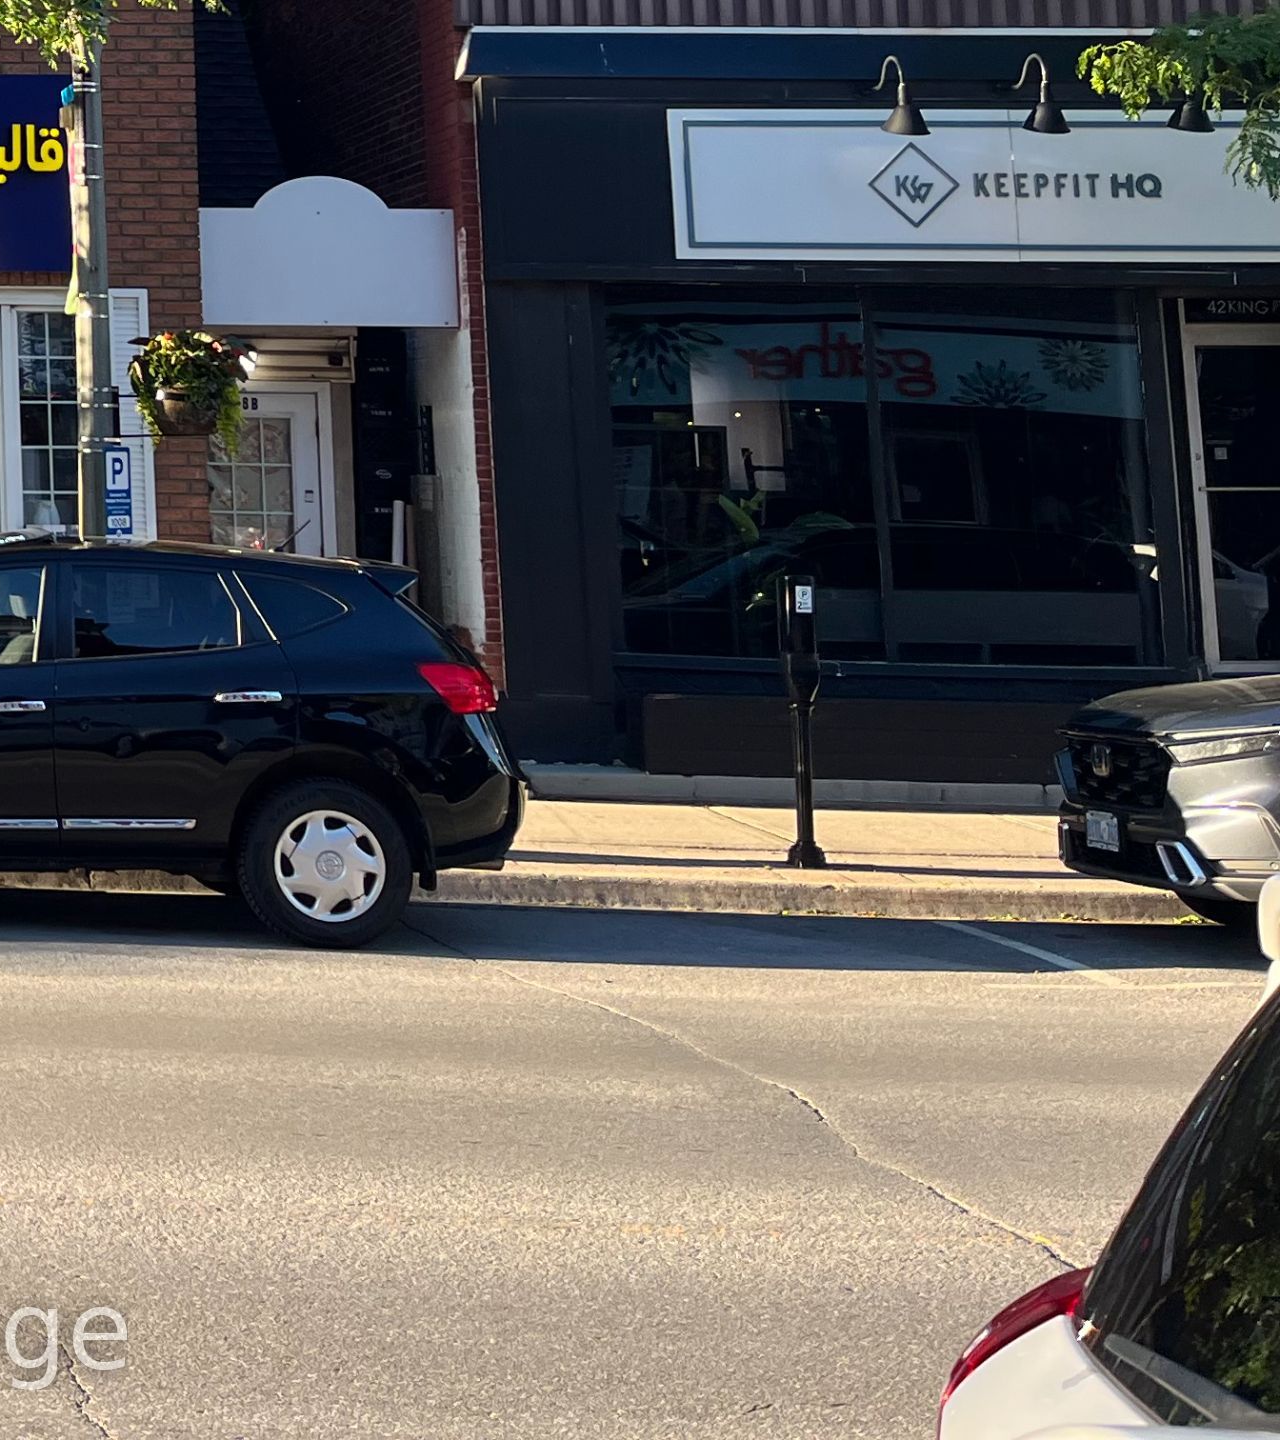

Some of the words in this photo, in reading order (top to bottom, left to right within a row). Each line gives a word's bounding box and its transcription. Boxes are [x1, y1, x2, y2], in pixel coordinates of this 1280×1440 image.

[973, 172, 1100, 198] KEEPFIT
[1110, 172, 1163, 199] HQ
[112, 457, 123, 485] P
